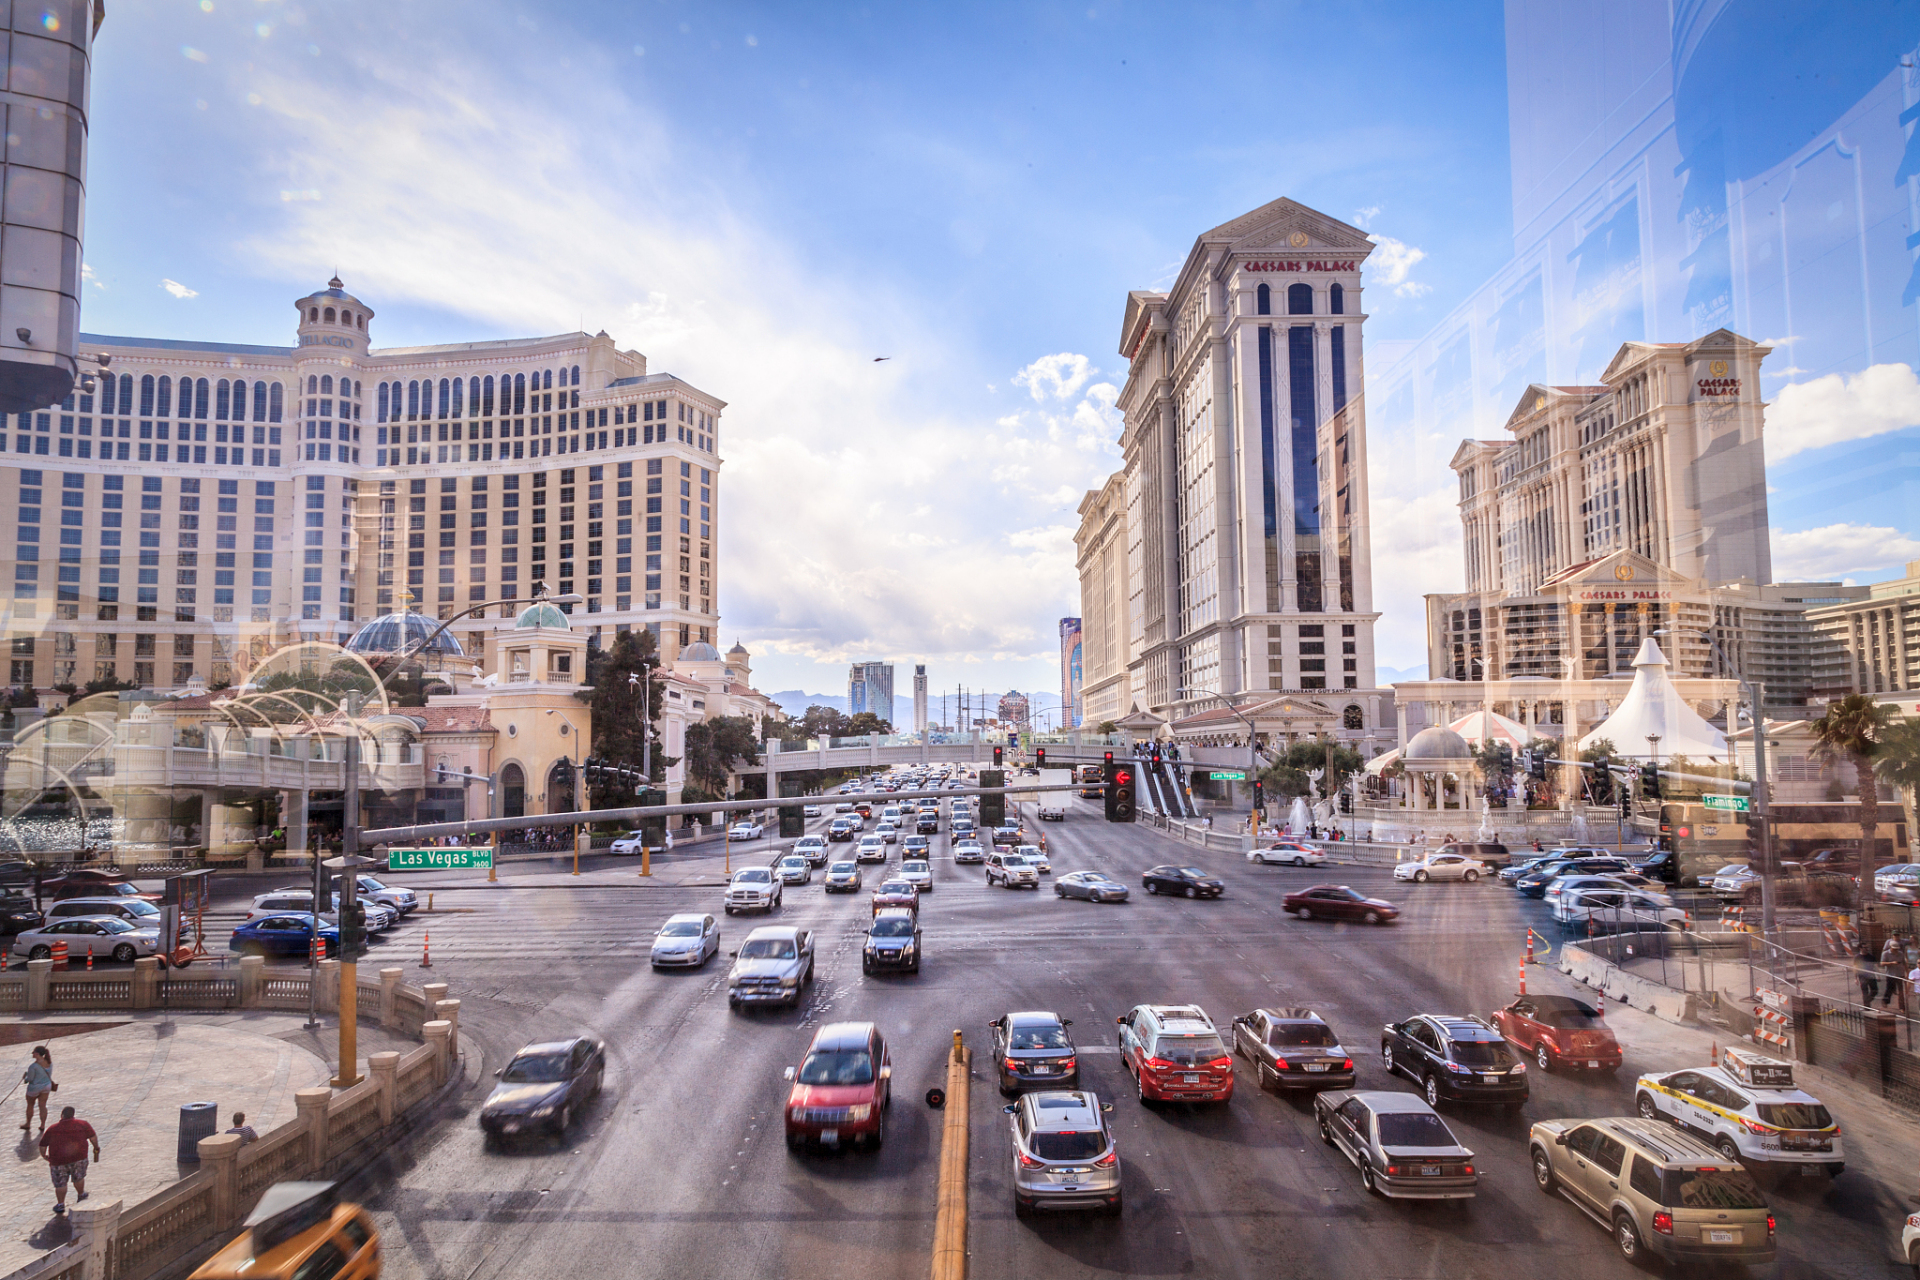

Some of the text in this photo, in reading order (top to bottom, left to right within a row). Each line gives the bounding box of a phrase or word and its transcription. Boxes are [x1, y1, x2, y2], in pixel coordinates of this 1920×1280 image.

[1244, 261, 1356, 273] CAESARS PALACE
[299, 334, 355, 349] BELLAGIO
[1697, 378, 1743, 388] CAESARS
[1700, 387, 1741, 397] PALACE
[1579, 591, 1672, 600] CAESARS PALACE
[1706, 796, 1743, 810] Flamingo
[399, 851, 423, 865] Las
[427, 851, 468, 868] Vegas
[472, 850, 489, 858] BLVD
[1760, 1142, 1780, 1152] 5600
